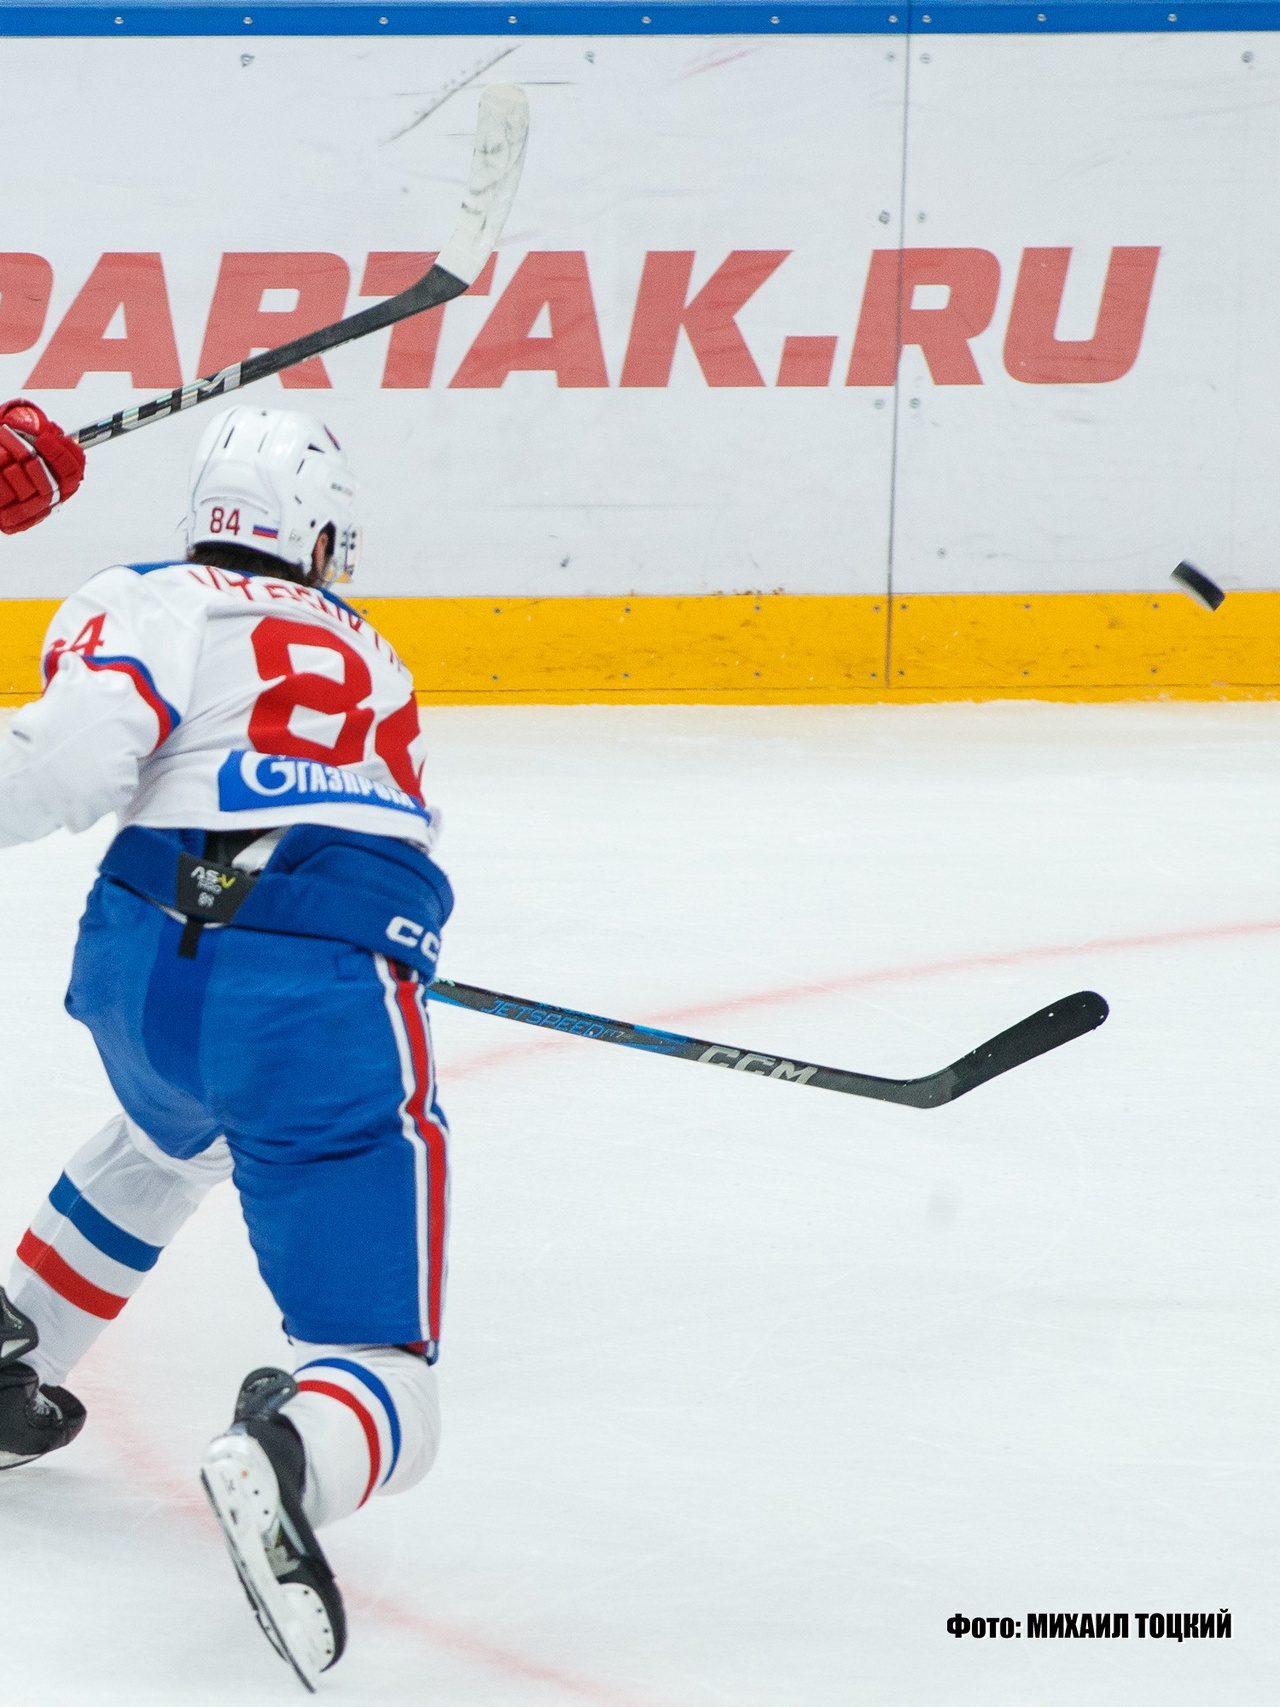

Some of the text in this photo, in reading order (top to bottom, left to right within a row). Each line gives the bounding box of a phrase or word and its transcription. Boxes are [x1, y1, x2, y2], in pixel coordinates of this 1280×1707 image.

[210, 506, 241, 536] 84
[481, 999, 603, 1039] JETSPEED
[697, 1044, 819, 1085] CCM
